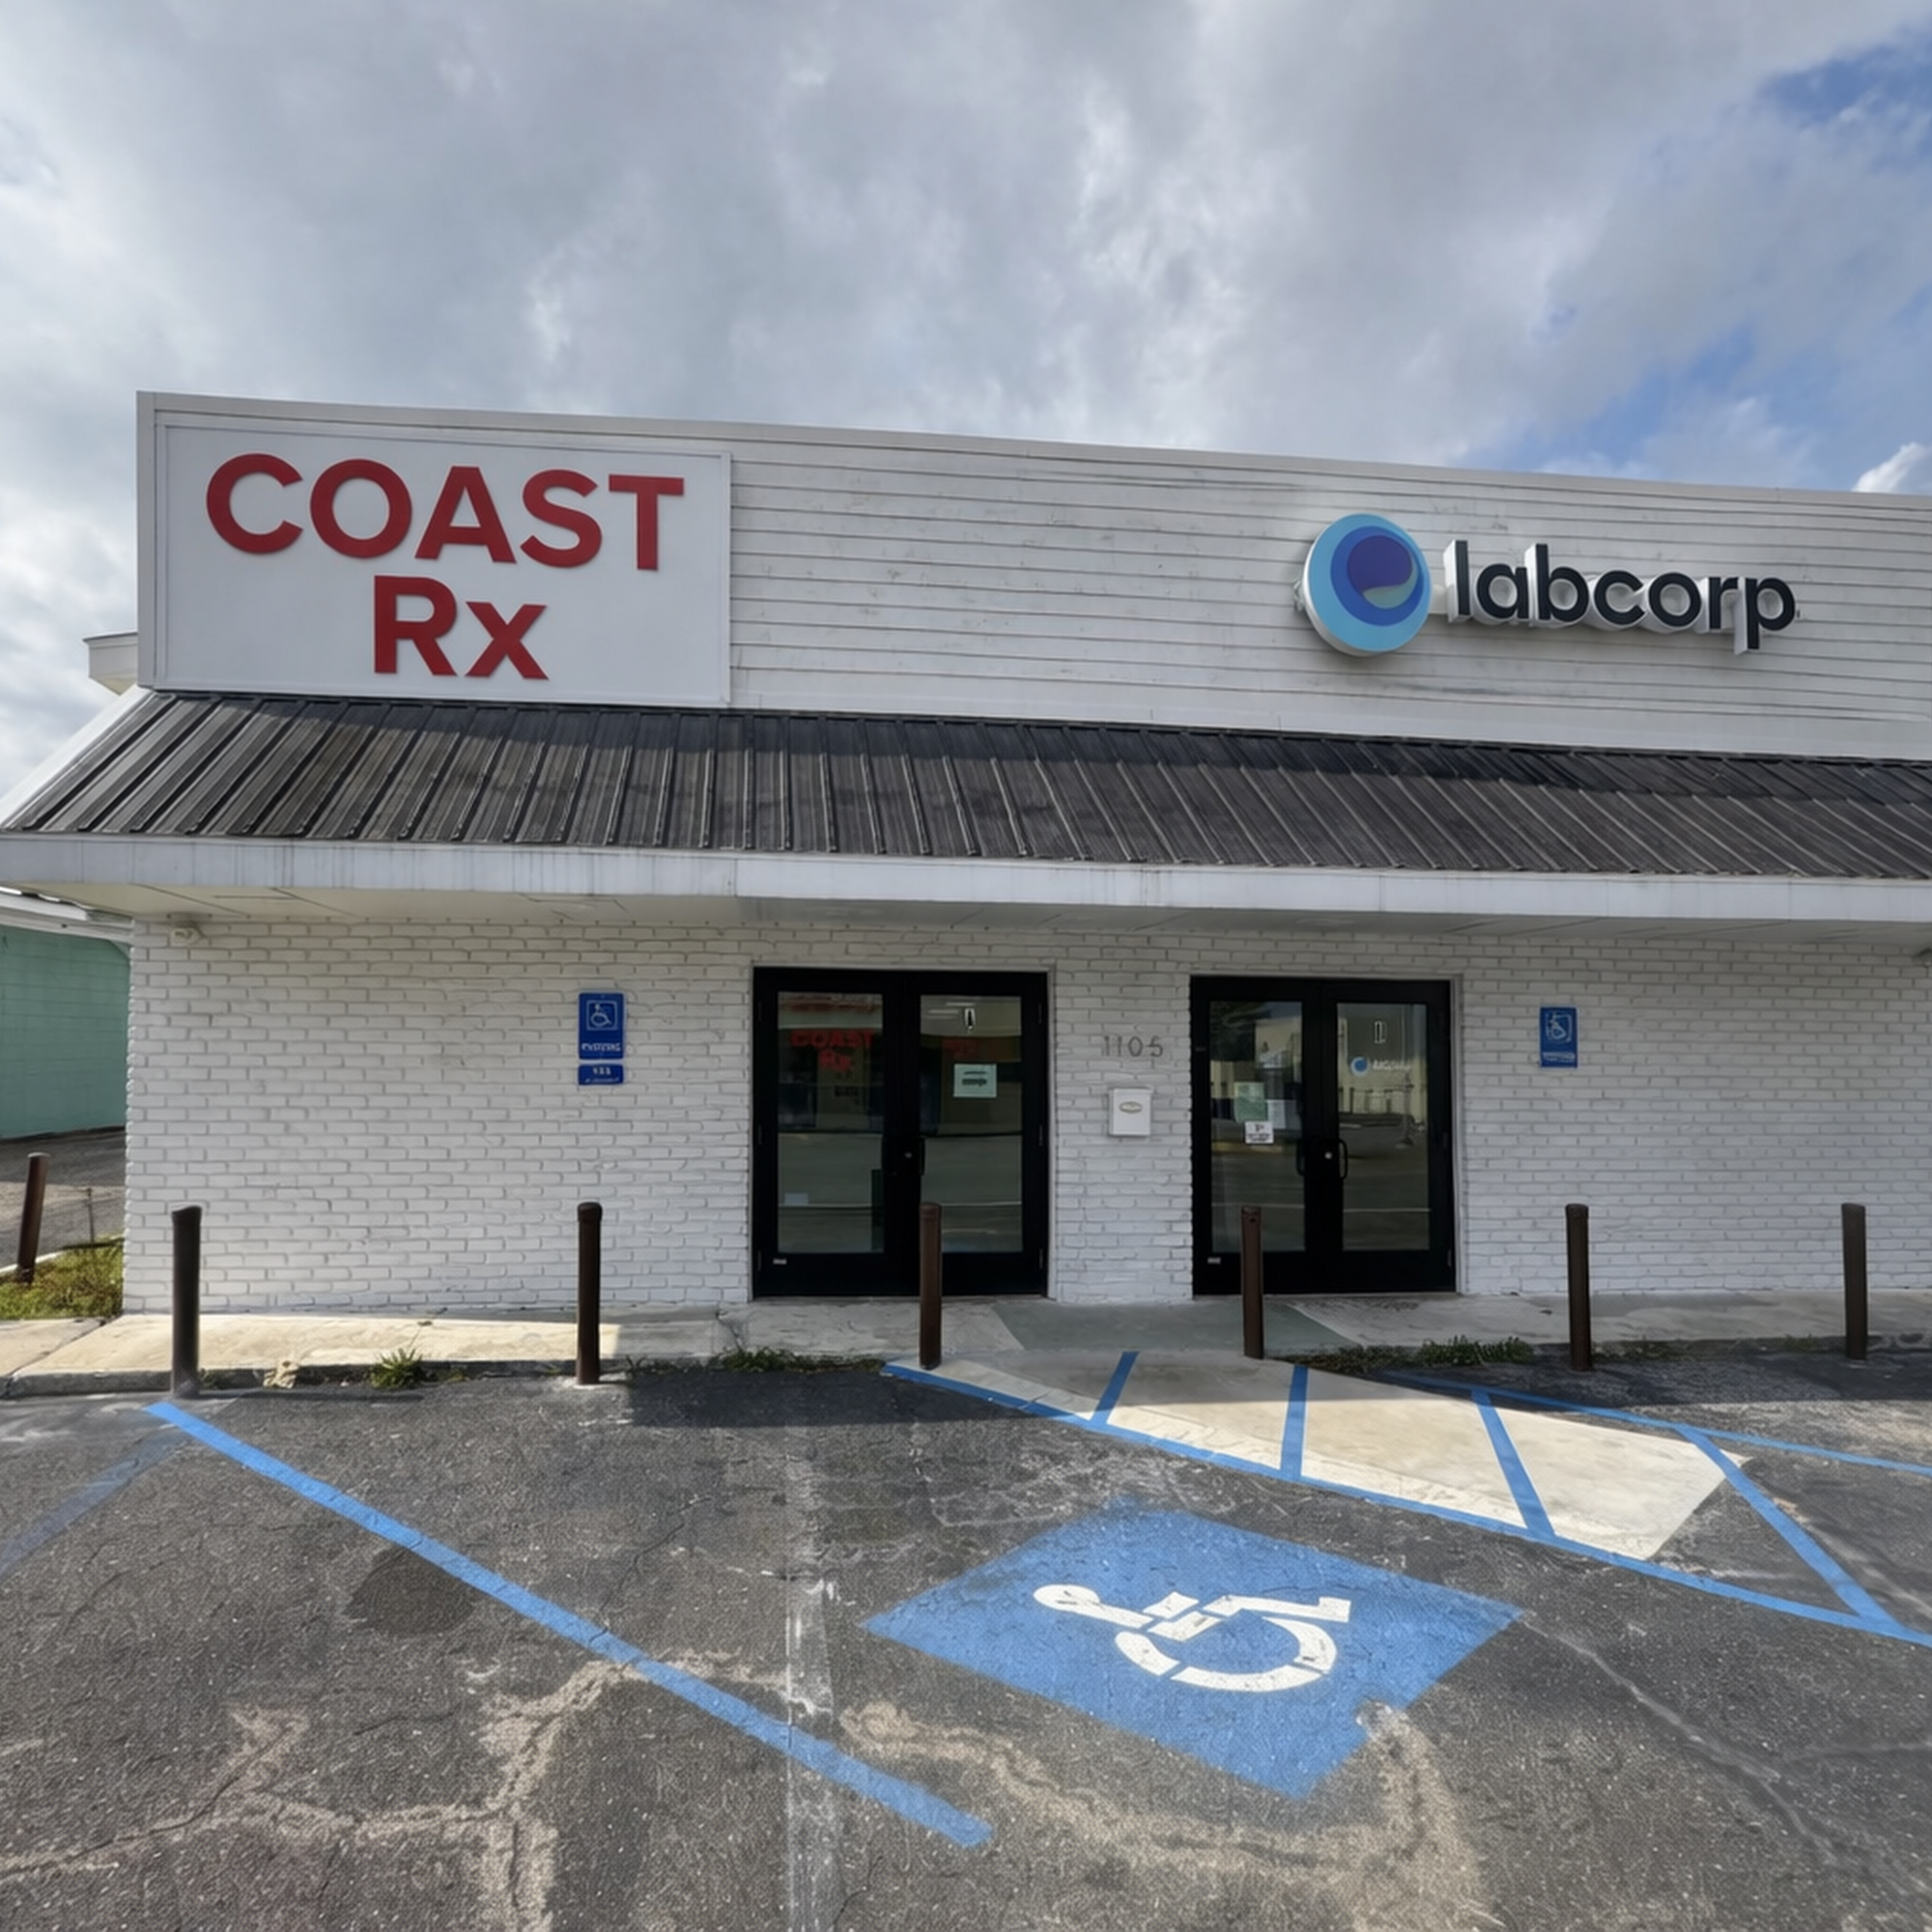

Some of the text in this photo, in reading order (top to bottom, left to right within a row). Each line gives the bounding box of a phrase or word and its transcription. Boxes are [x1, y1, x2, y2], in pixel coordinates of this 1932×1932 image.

[207, 454, 684, 570] COAST
[374, 575, 548, 680] Rx
[1456, 539, 1795, 649] labcorp
[1104, 1036, 1163, 1058] 1105
